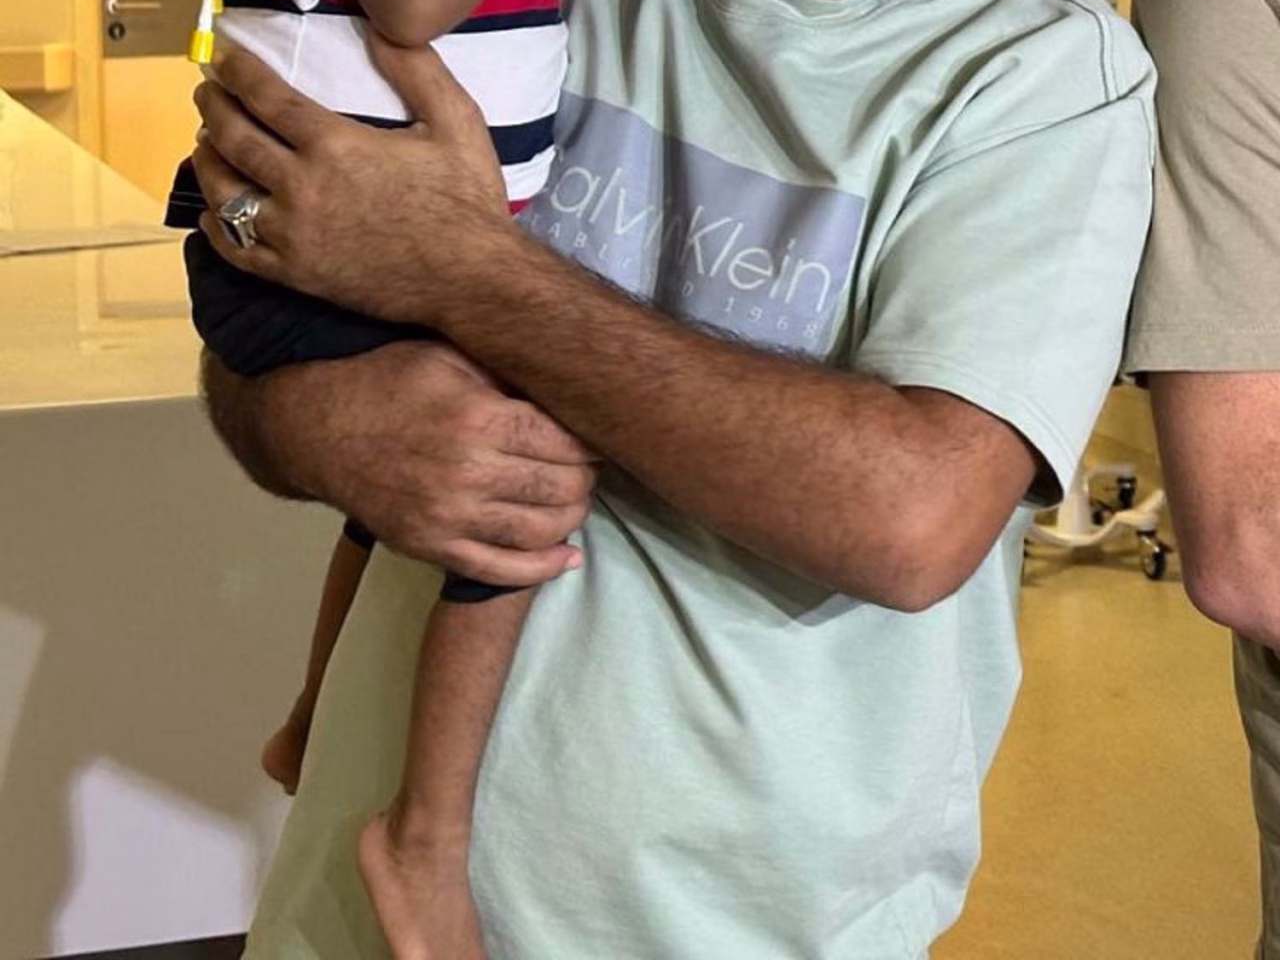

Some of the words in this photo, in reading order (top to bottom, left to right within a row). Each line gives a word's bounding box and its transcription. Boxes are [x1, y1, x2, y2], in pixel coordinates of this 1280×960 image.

[544, 149, 684, 265] alvin
[680, 205, 831, 313] Klein
[723, 296, 819, 338] 1968
